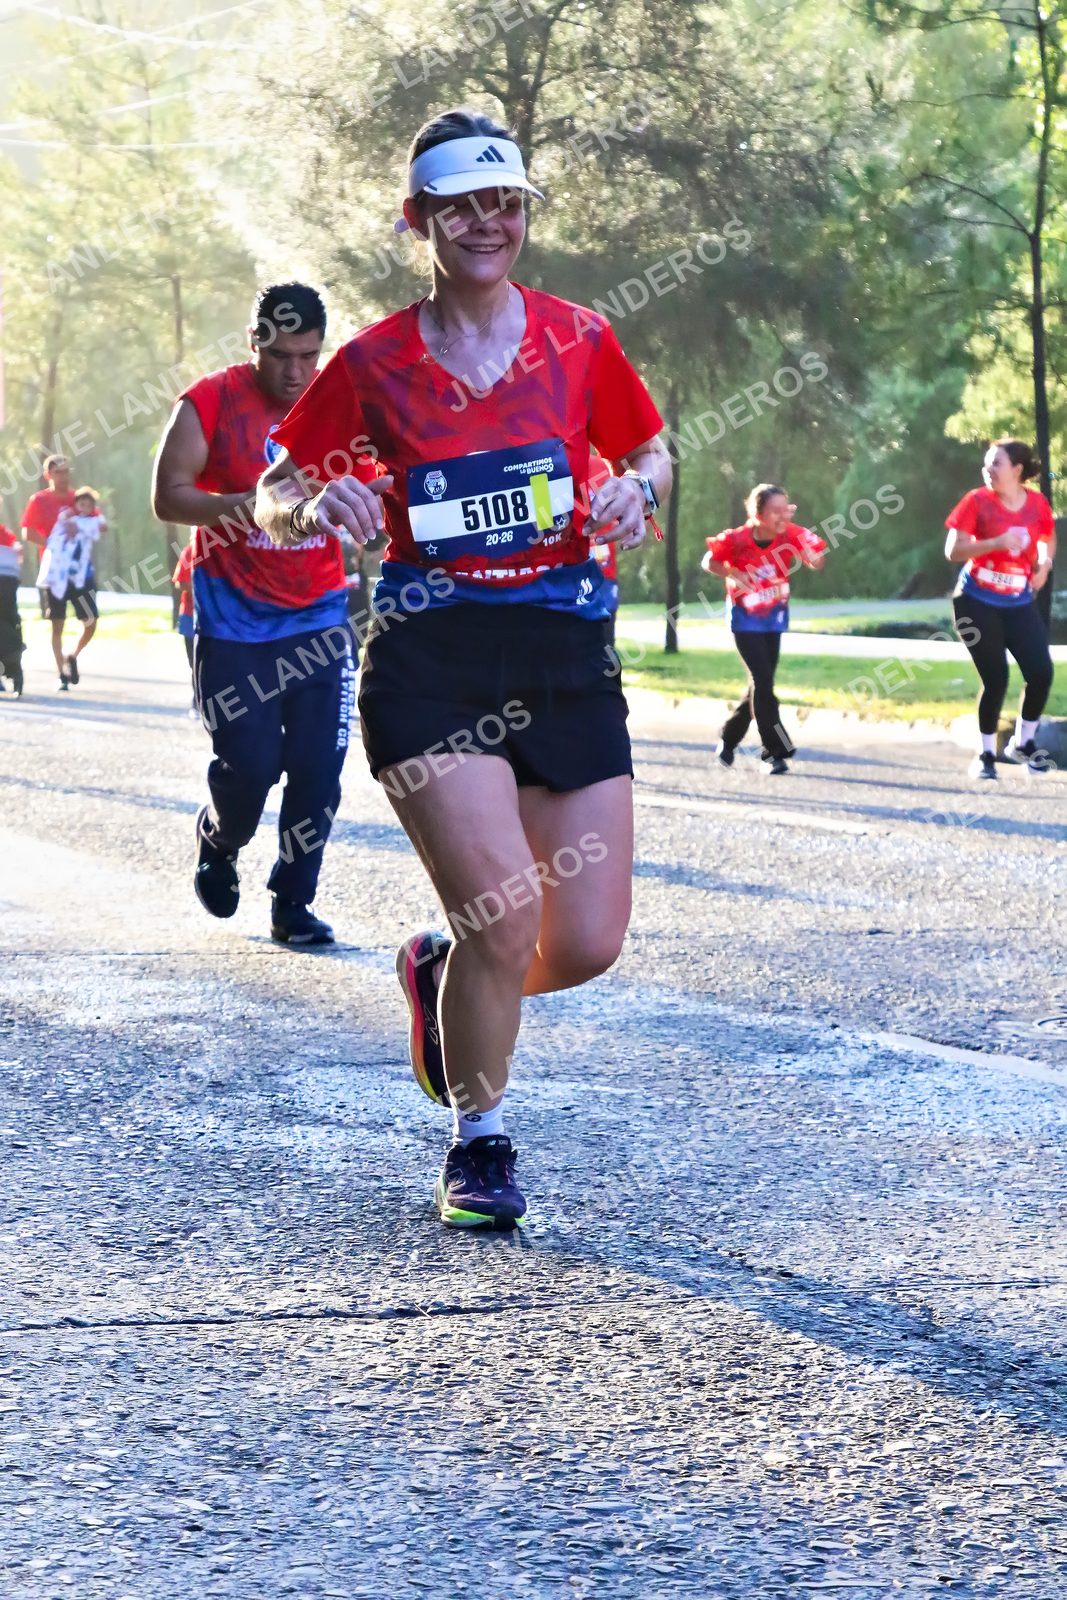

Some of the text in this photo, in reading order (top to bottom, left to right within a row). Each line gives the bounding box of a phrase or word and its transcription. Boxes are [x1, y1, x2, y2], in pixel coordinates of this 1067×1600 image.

[503, 457, 552, 473] COMPARTIMOS
[461, 490, 529, 531] 5108
[542, 533, 562, 546] 10K
